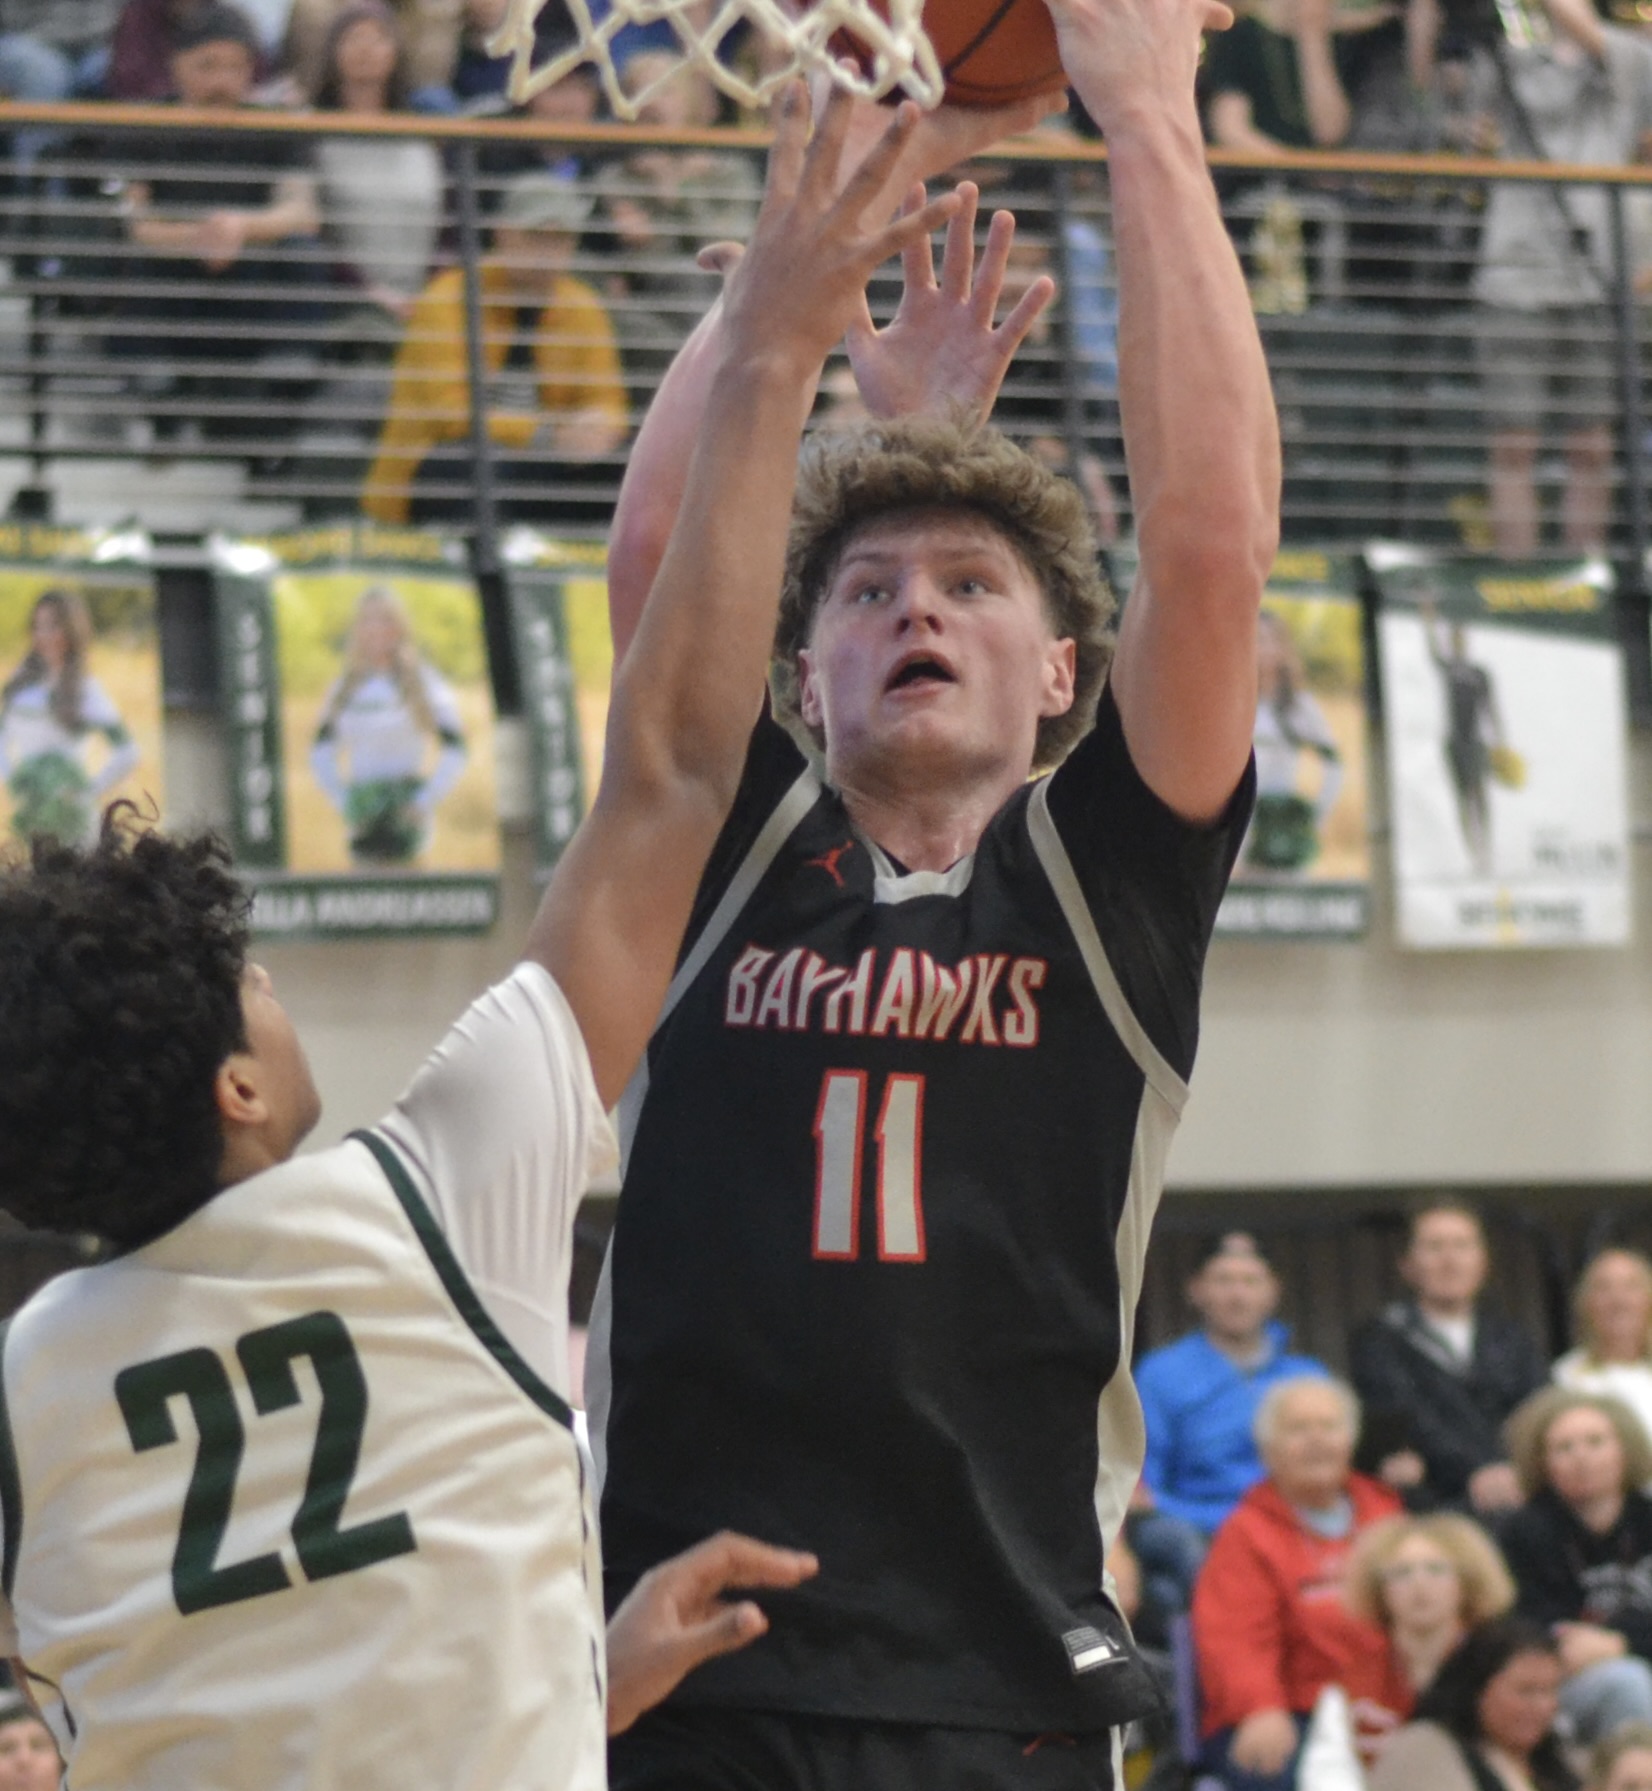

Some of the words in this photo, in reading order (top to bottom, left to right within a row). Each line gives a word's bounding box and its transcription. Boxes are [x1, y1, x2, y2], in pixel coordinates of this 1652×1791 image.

[725, 942, 1047, 1048] BAYHAWKS
[812, 1068, 926, 1263] 11
[114, 1310, 418, 1616] 22
